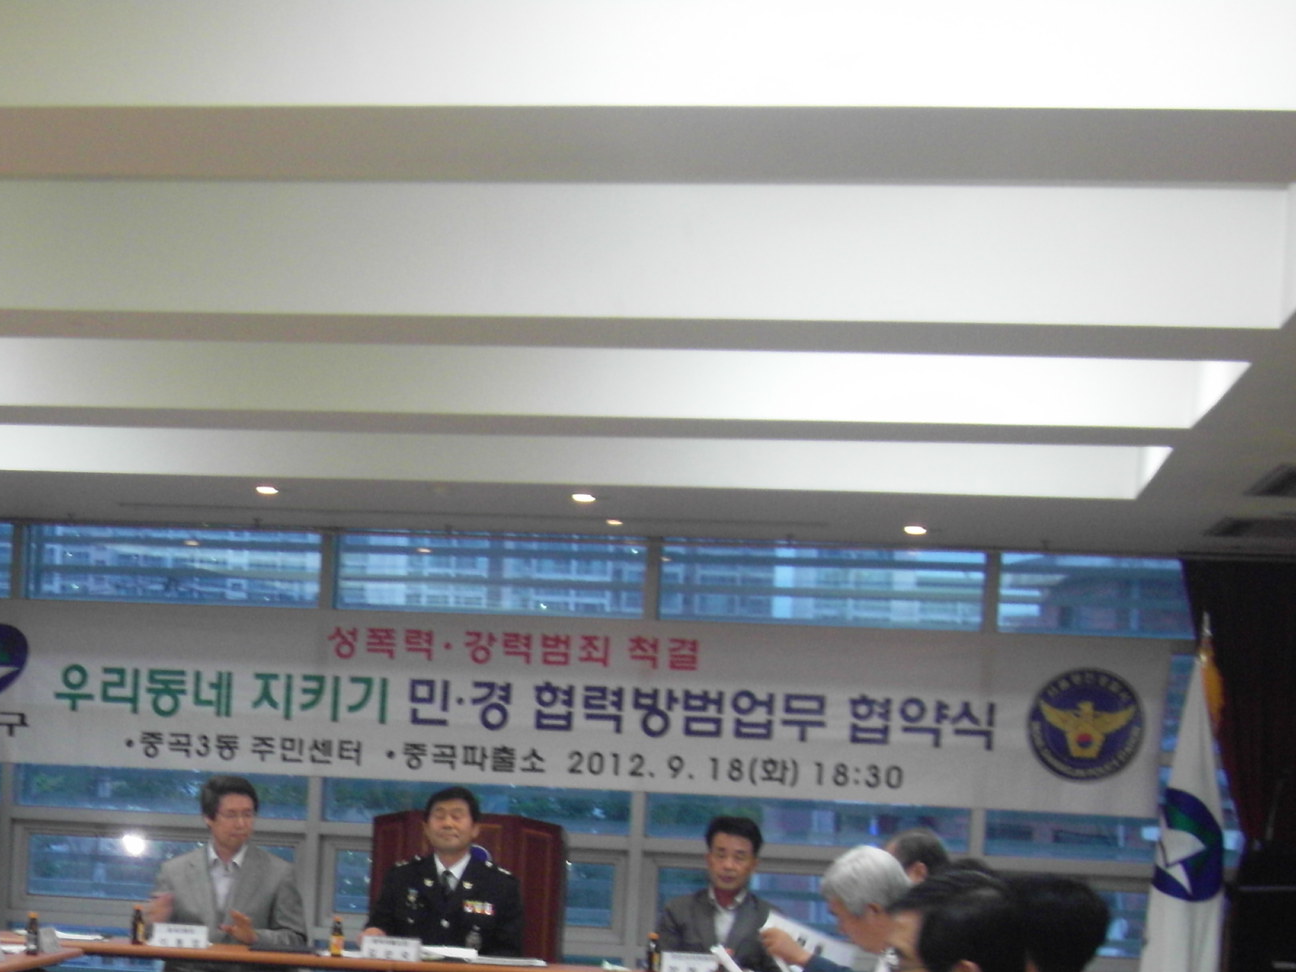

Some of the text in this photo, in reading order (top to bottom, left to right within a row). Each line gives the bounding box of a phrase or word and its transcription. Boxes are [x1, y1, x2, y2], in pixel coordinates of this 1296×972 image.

[628, 635, 700, 671] 척결
[54, 664, 234, 718] 우리동네
[252, 672, 388, 725] 지키기
[533, 681, 827, 742] 협력방범업무
[848, 694, 995, 751] 협약식
[251, 735, 362, 766] 주민센터
[814, 761, 904, 790] 18:30
